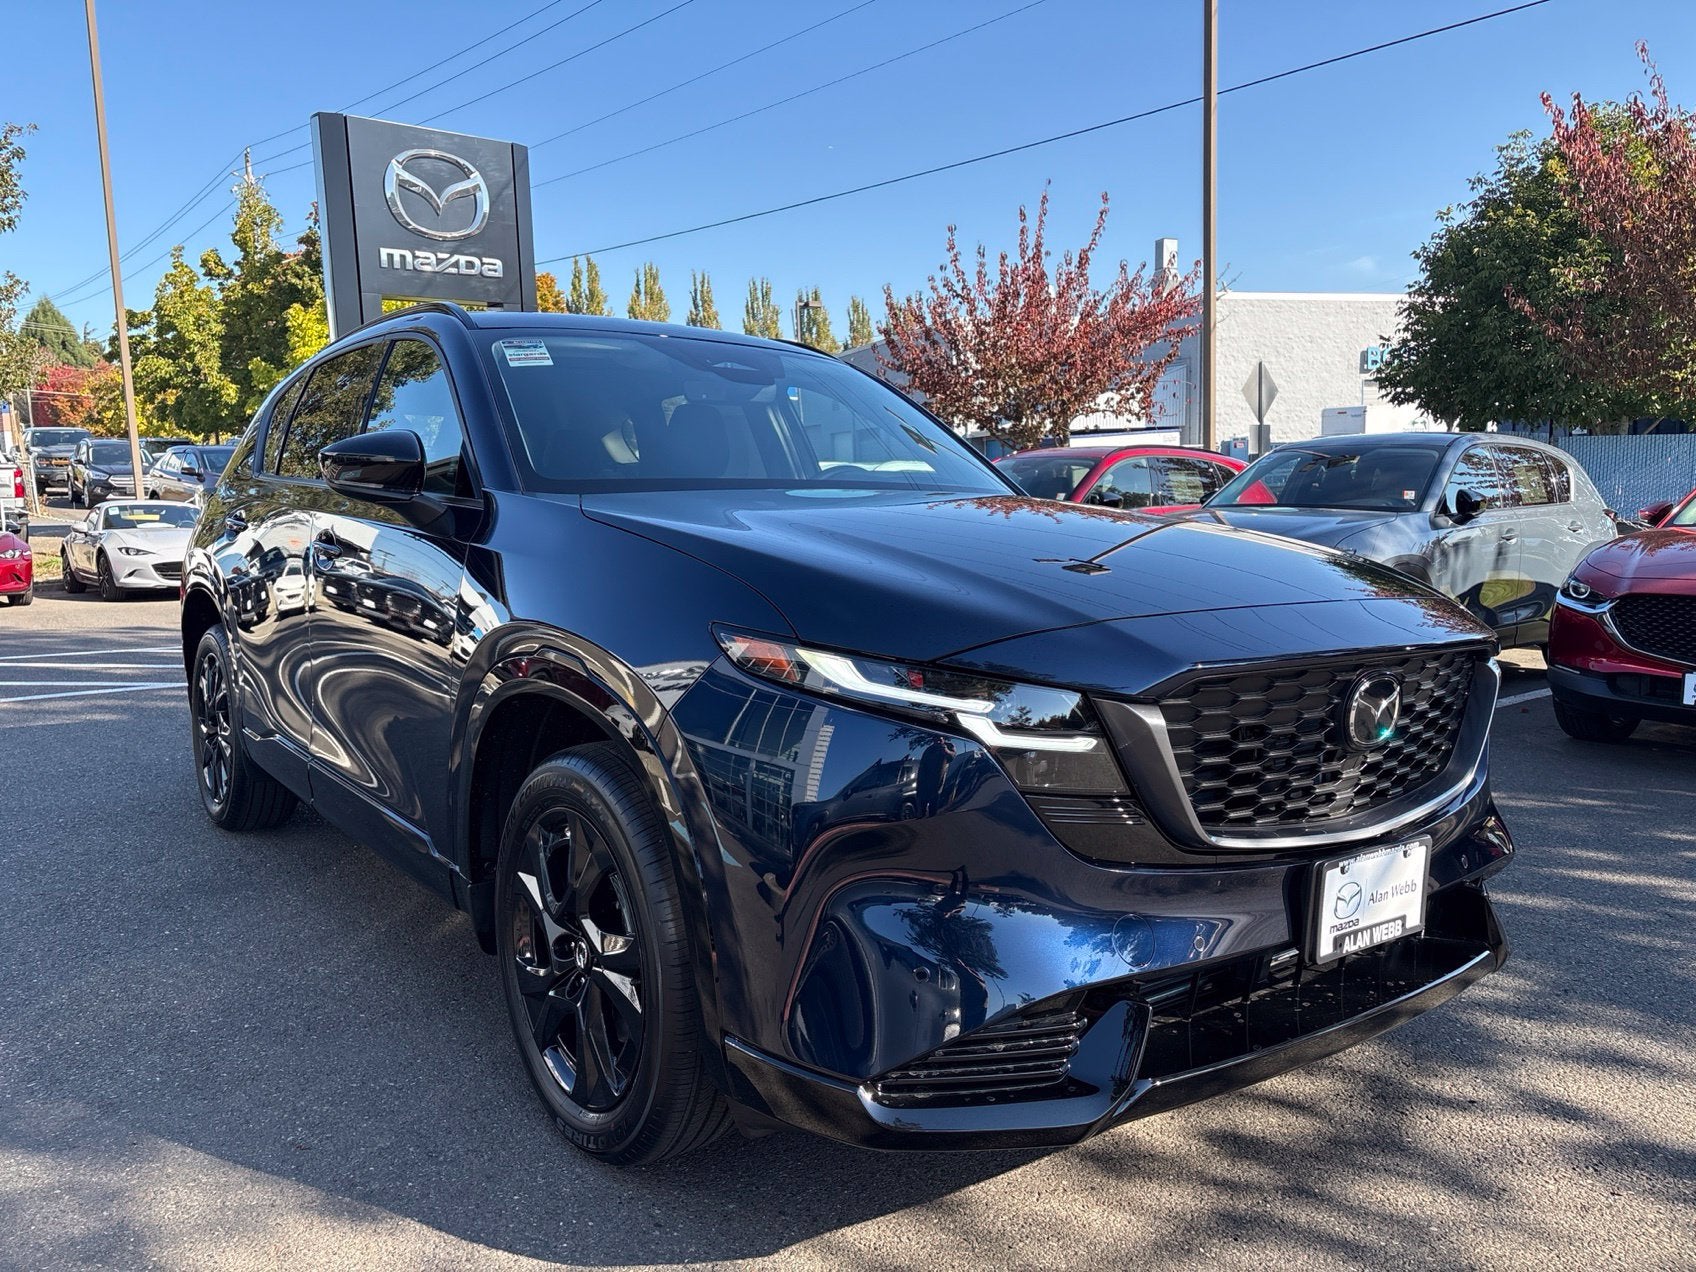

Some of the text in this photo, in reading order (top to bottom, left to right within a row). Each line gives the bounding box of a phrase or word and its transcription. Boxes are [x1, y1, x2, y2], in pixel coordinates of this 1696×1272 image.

[1368, 879, 1417, 906] Alan Webb
[1343, 919, 1402, 953] ALAN WEBB
